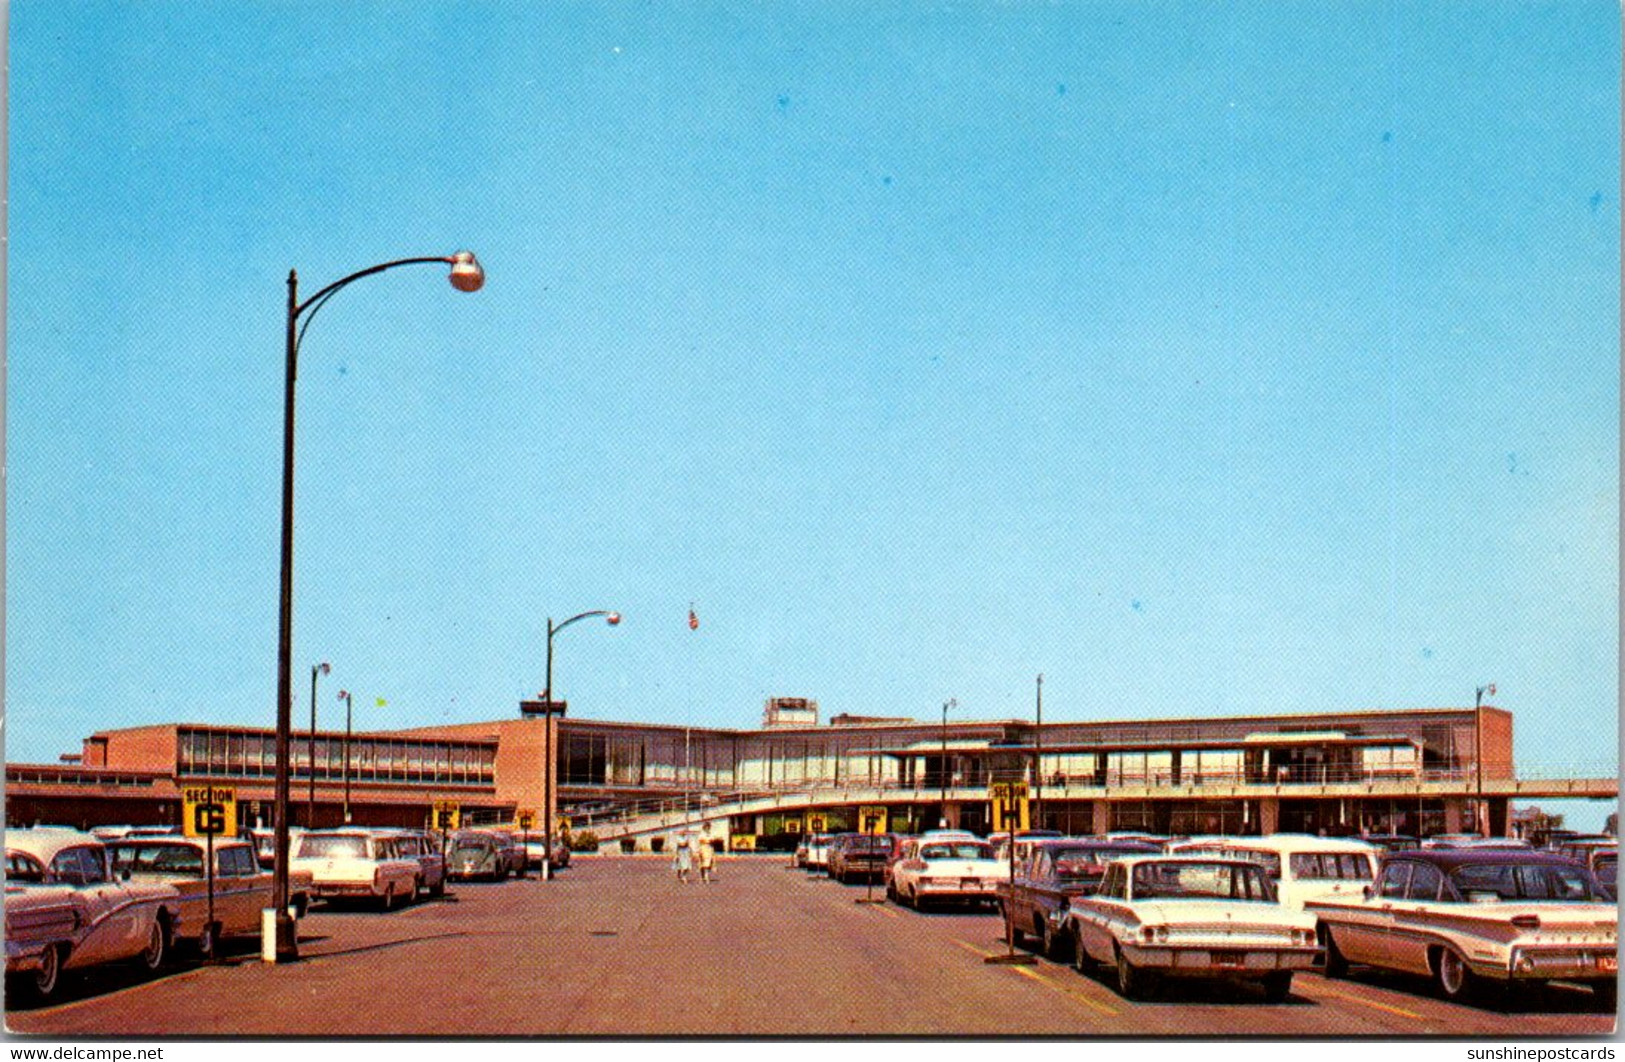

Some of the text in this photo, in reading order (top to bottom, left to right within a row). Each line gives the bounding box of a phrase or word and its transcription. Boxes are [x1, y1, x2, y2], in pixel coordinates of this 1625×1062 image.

[186, 789, 233, 802] SECION
[994, 785, 1026, 798] SECION
[195, 803, 225, 834] G
[438, 810, 453, 829] E
[1000, 798, 1021, 829] H
[865, 815, 881, 832] F
